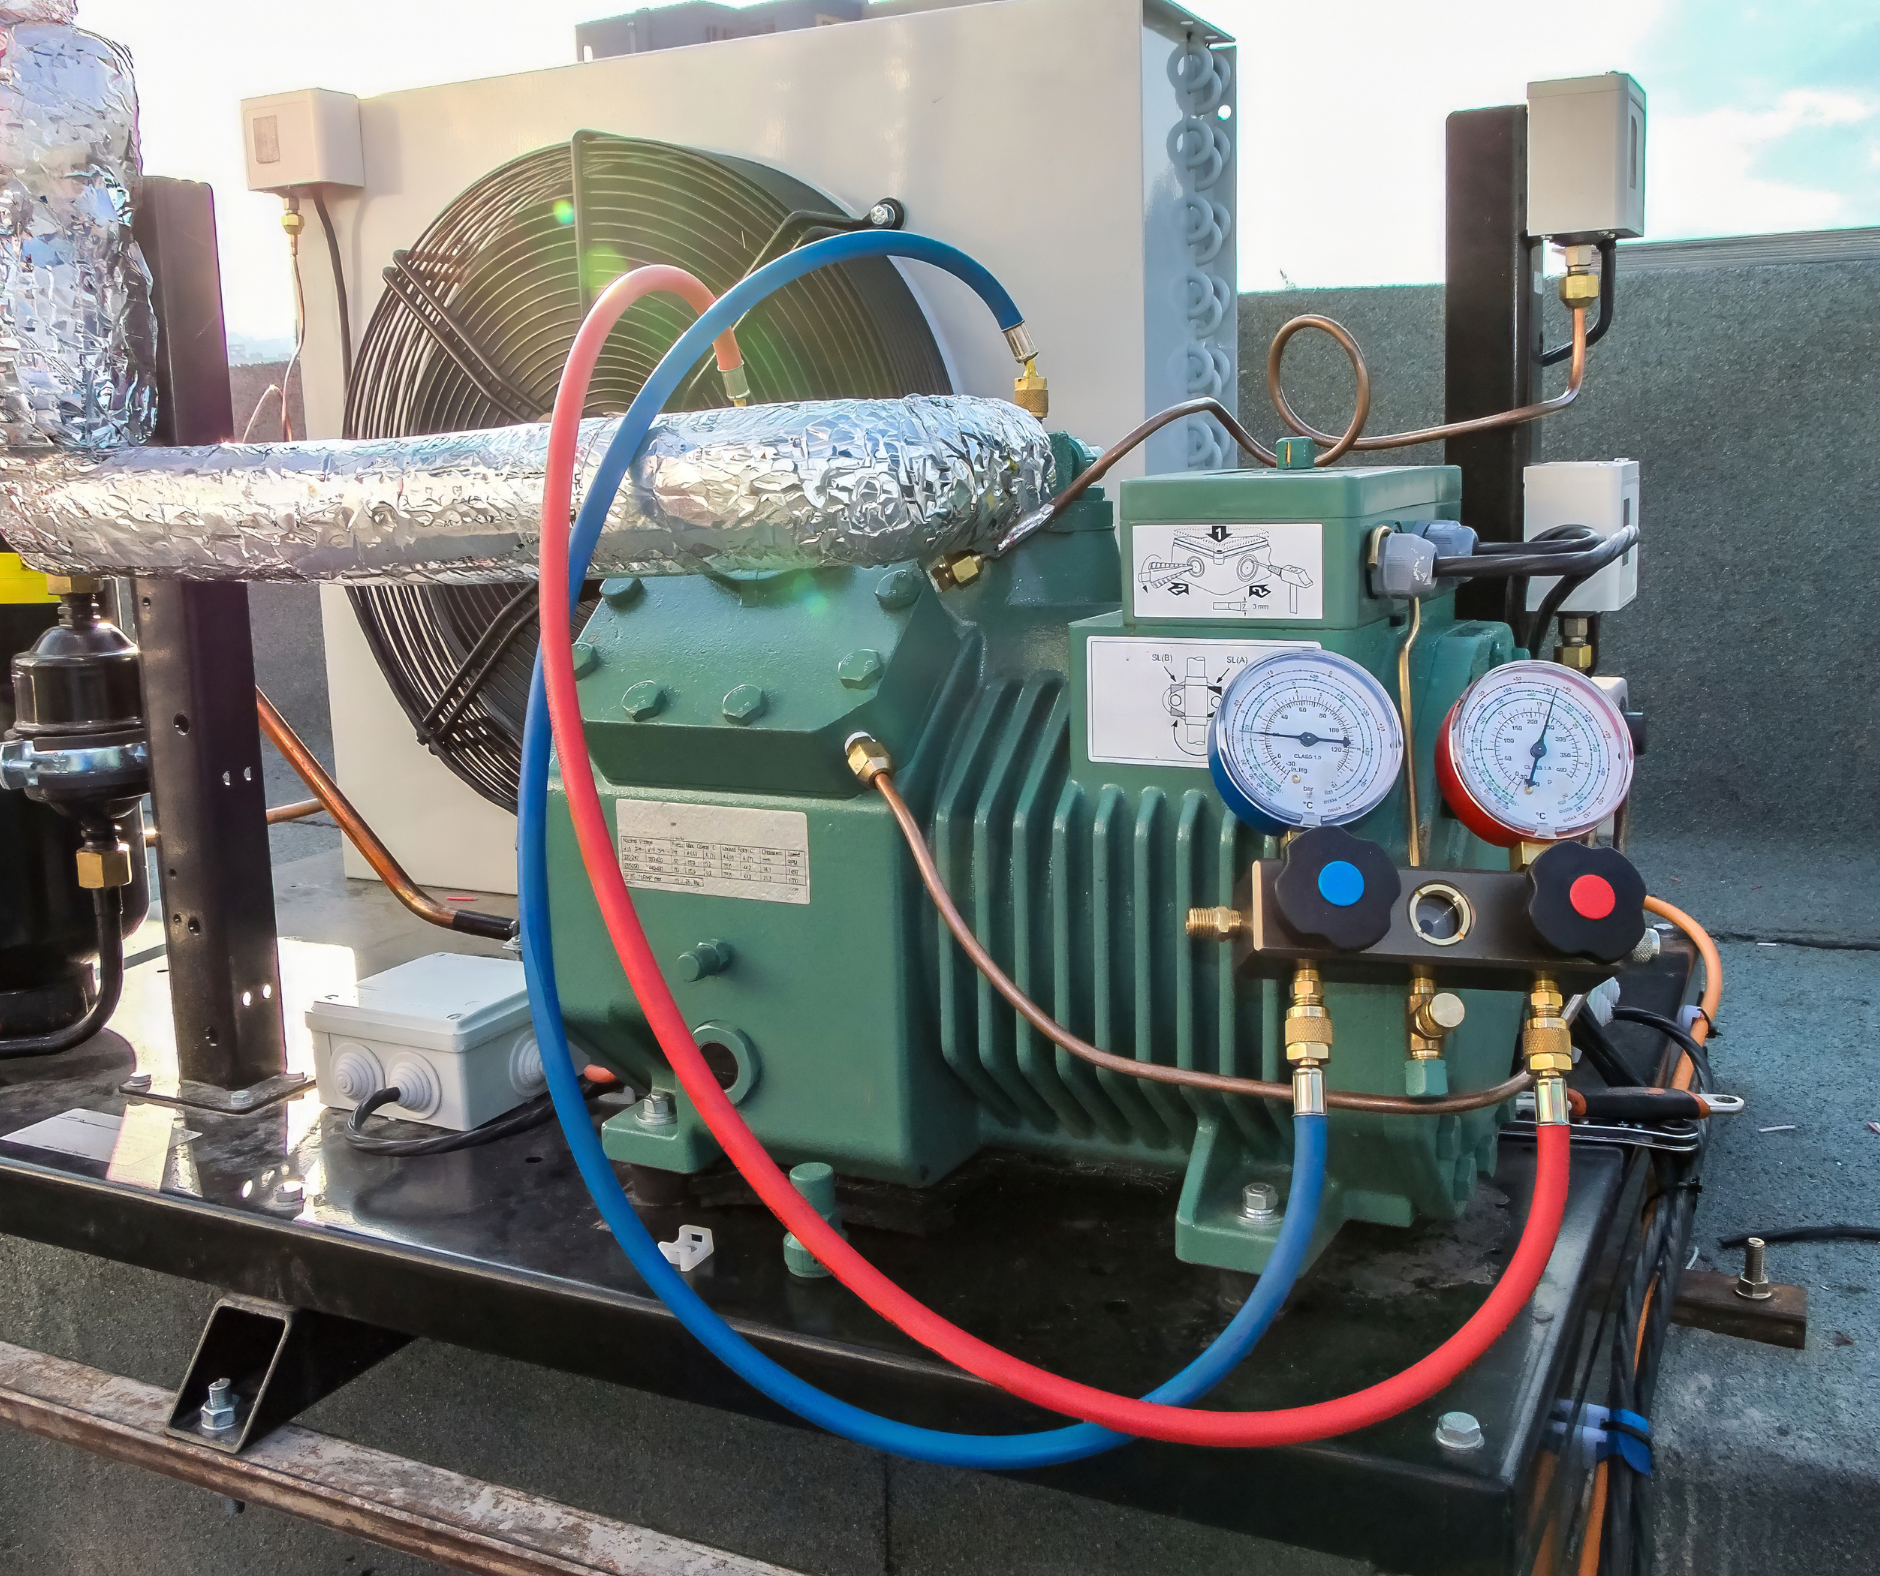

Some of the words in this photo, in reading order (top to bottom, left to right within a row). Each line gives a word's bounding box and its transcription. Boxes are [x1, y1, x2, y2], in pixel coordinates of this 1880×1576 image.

[1216, 527, 1222, 539] 1
[1151, 653, 1173, 663] SL(B)
[1226, 656, 1249, 666] SL(A)
